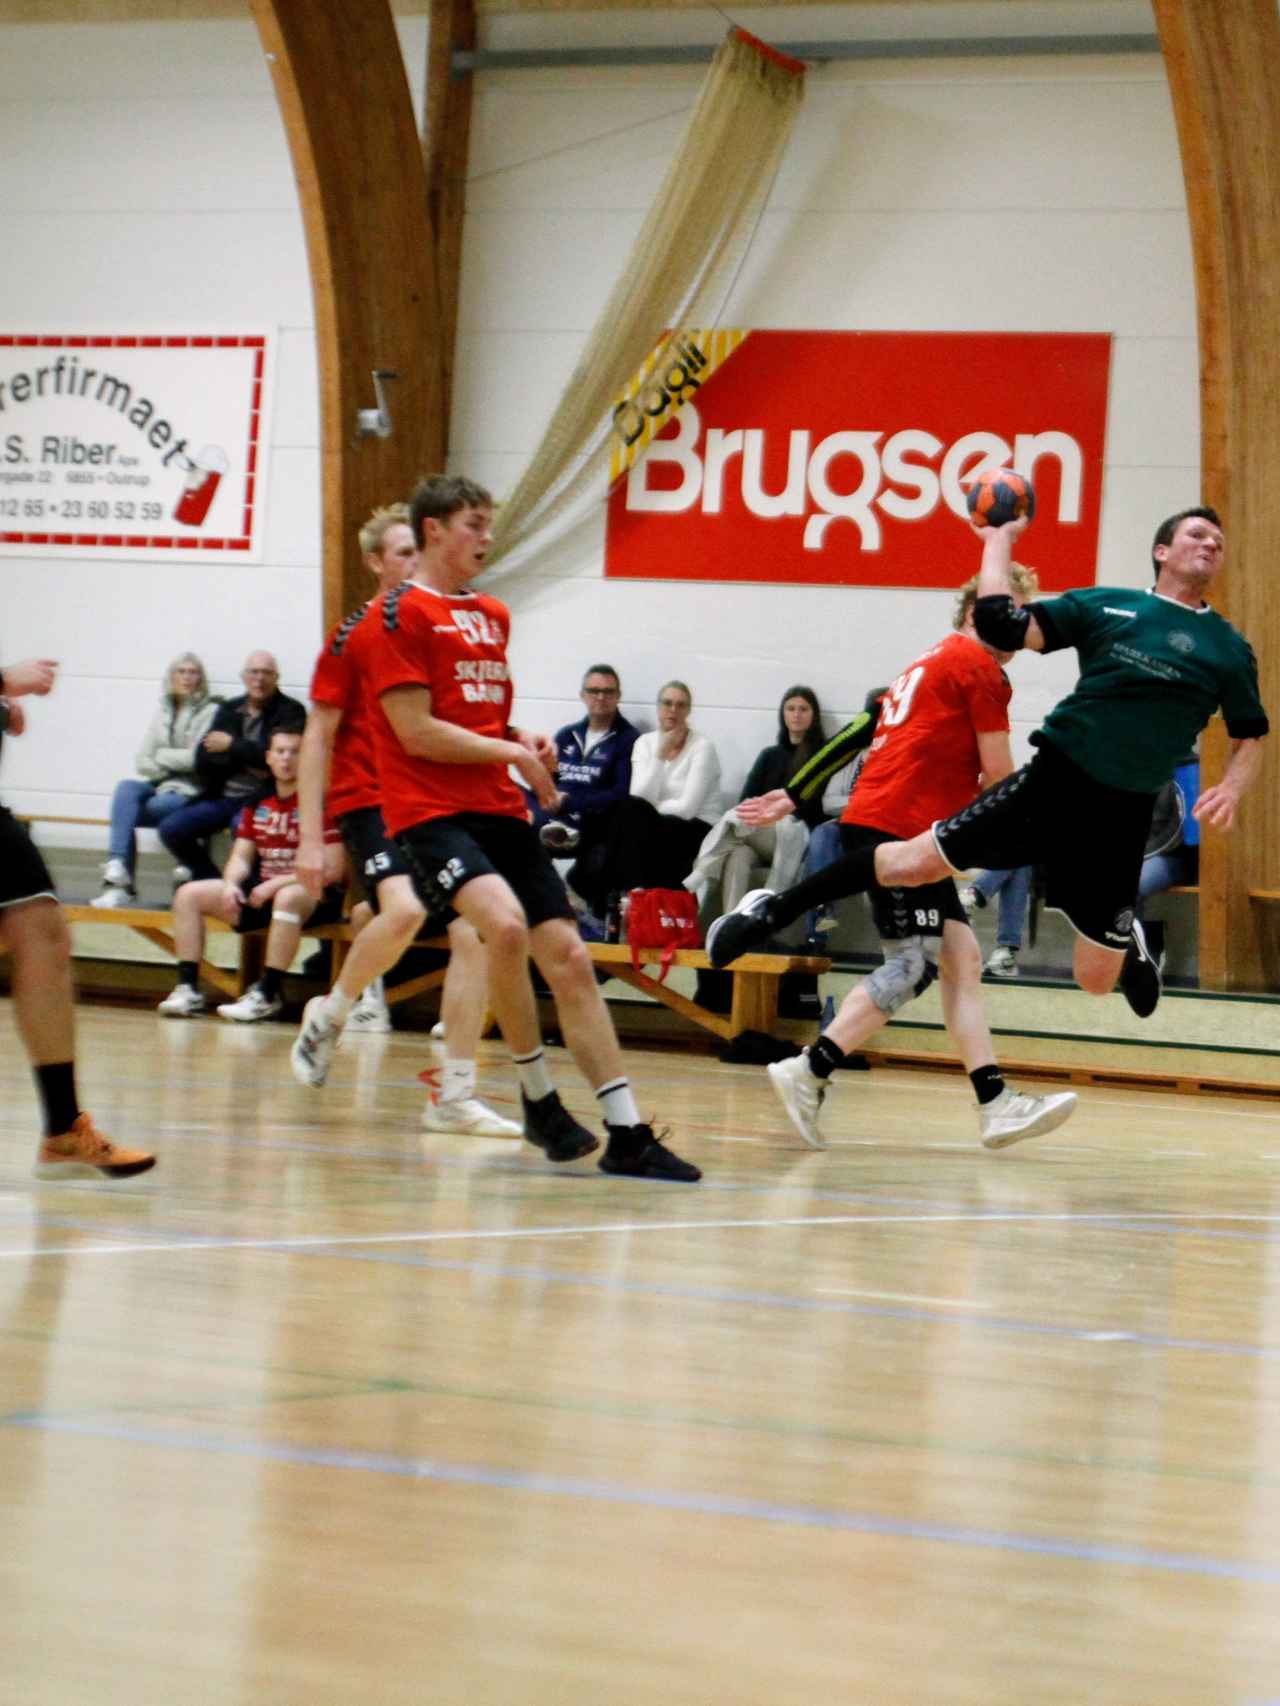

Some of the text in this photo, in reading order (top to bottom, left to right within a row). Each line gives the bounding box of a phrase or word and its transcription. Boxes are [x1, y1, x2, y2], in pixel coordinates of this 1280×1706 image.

[0, 355, 187, 467] erfirmaet
[42, 436, 117, 464] Riber
[626, 400, 1082, 550] Brugsen
[914, 908, 940, 928] 89
